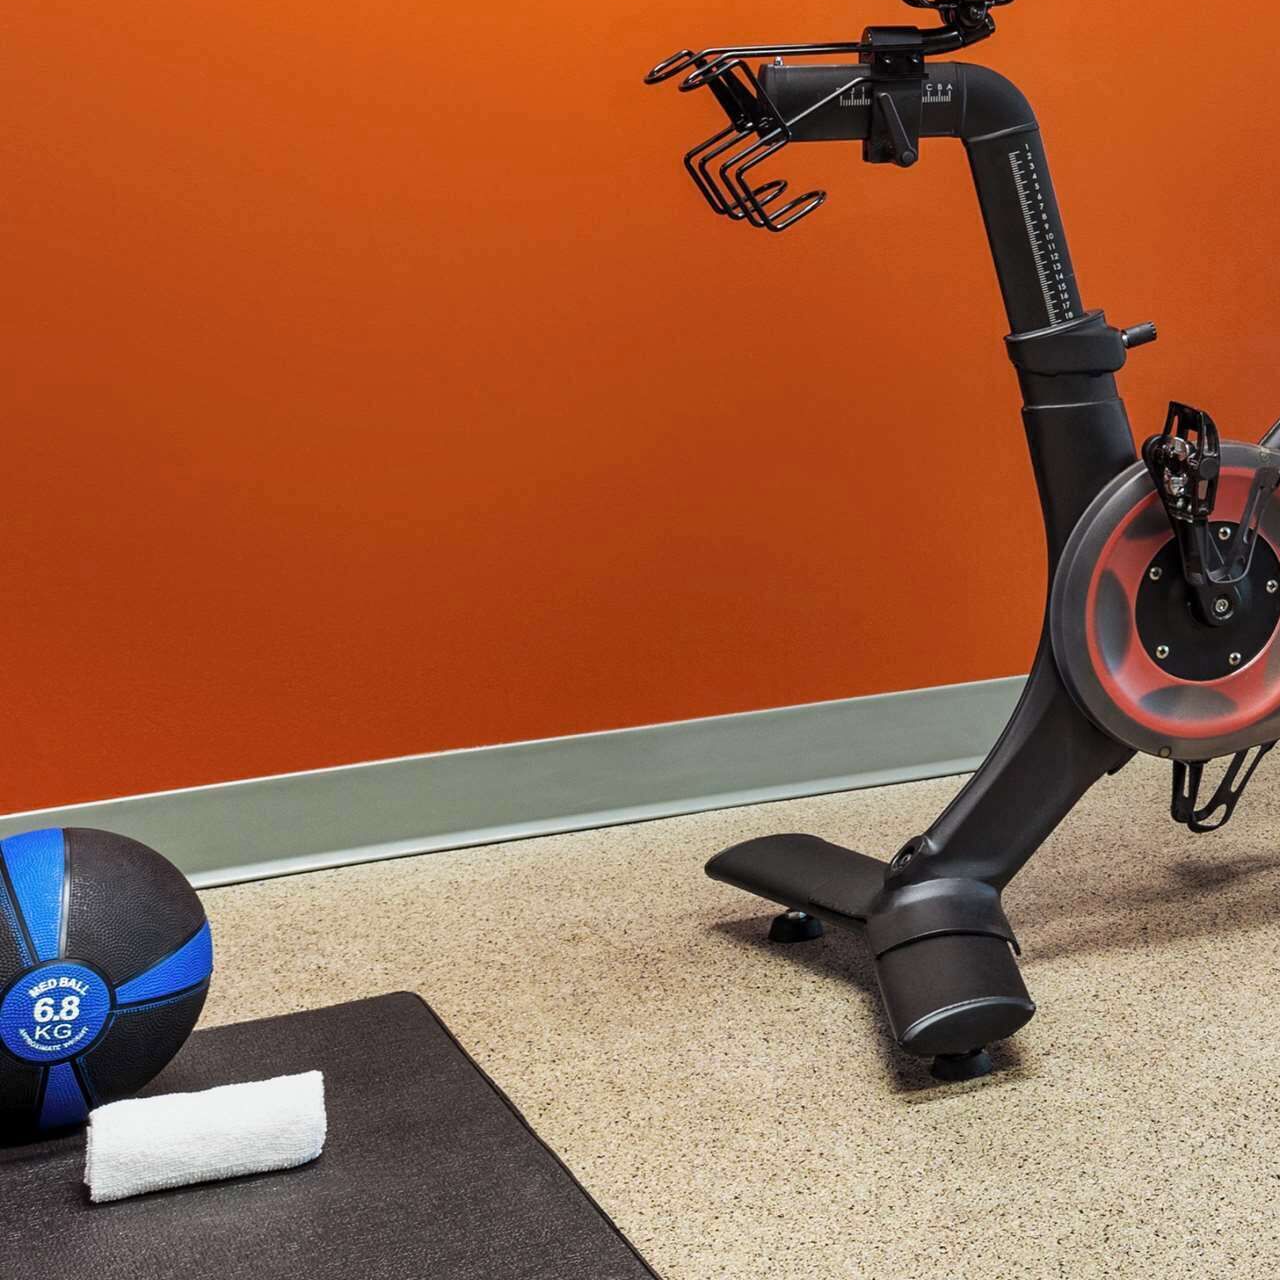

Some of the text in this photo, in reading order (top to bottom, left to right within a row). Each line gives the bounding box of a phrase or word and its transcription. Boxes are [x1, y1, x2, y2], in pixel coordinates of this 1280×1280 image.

[926, 83, 933, 91] C
[1045, 232, 1055, 241] 10
[1047, 242, 1056, 251] 11
[1050, 252, 1059, 261] 12
[1053, 262, 1062, 271] 13
[1055, 272, 1064, 280] 14
[1058, 282, 1067, 291] 15
[1060, 291, 1069, 300] 16
[1062, 301, 1070, 310] 17
[1065, 311, 1074, 320] 18
[28, 977, 89, 998] MED BALL
[33, 995, 80, 1023] 6.8
[34, 1023, 72, 1040] KG
